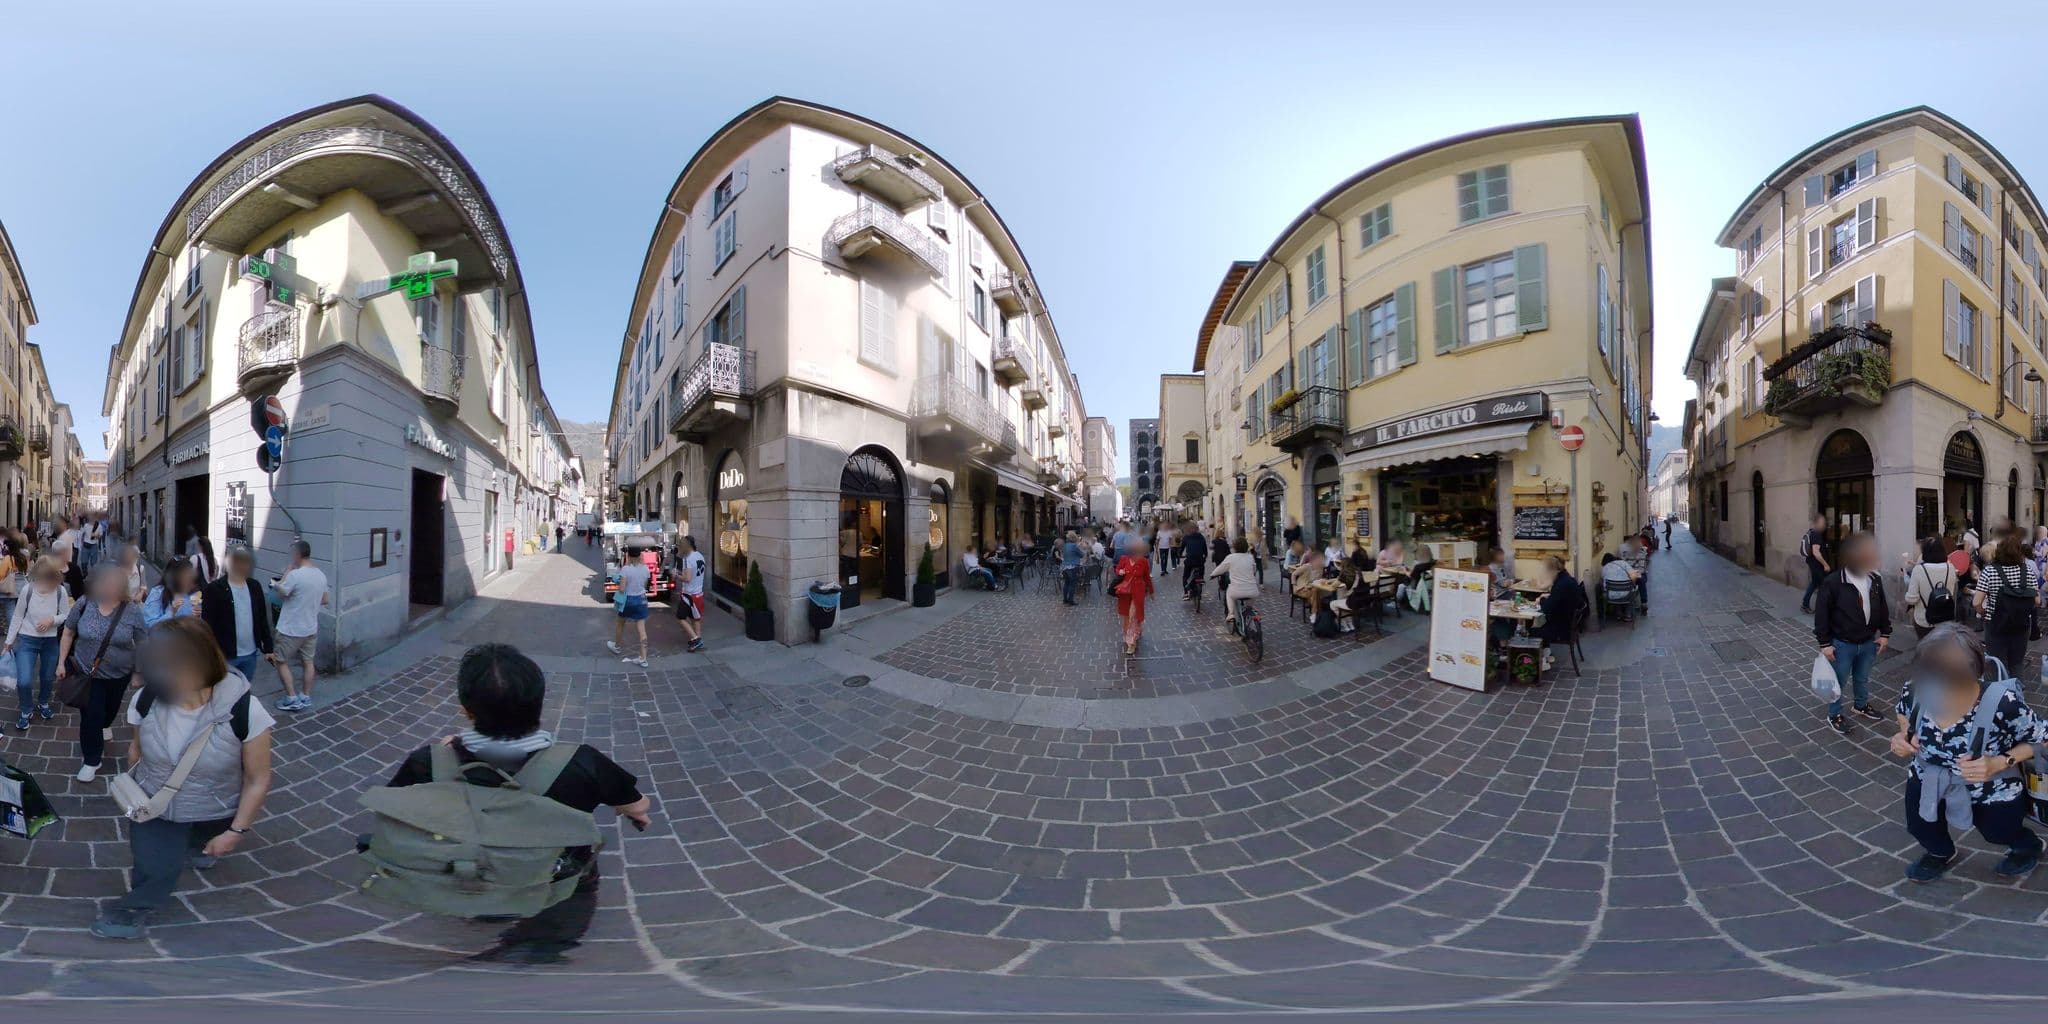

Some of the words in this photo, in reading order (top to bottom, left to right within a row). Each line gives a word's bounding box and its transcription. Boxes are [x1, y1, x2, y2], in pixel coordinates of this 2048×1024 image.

[407, 423, 458, 461] FARMACIA
[1376, 427, 1391, 443] IL
[1396, 407, 1477, 437] FARCITO
[172, 441, 209, 465] FARMACIA
